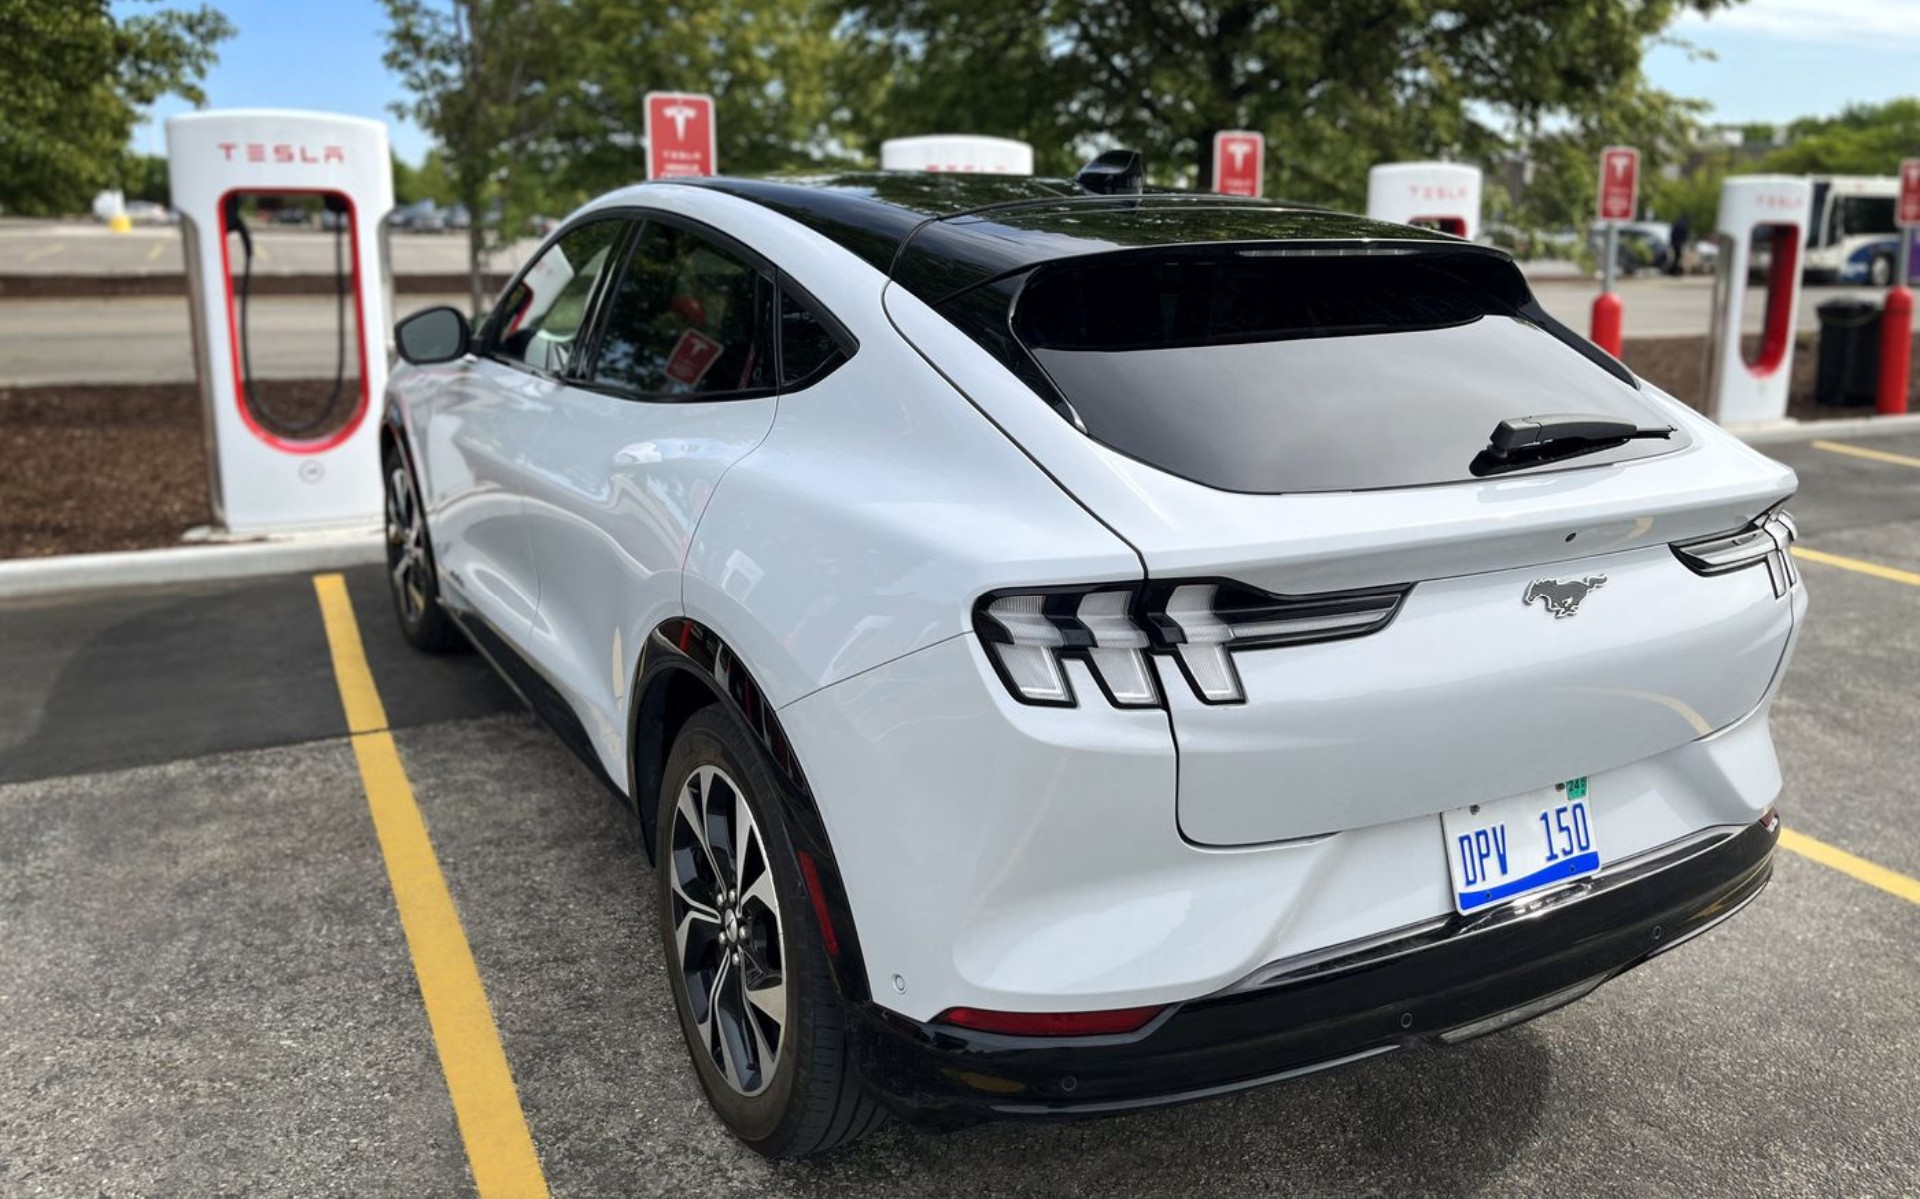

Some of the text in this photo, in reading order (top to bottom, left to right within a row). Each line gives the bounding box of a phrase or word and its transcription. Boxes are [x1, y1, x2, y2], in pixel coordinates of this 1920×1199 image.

[217, 143, 345, 163] TESLA
[1458, 802, 1590, 887] DPV 150
